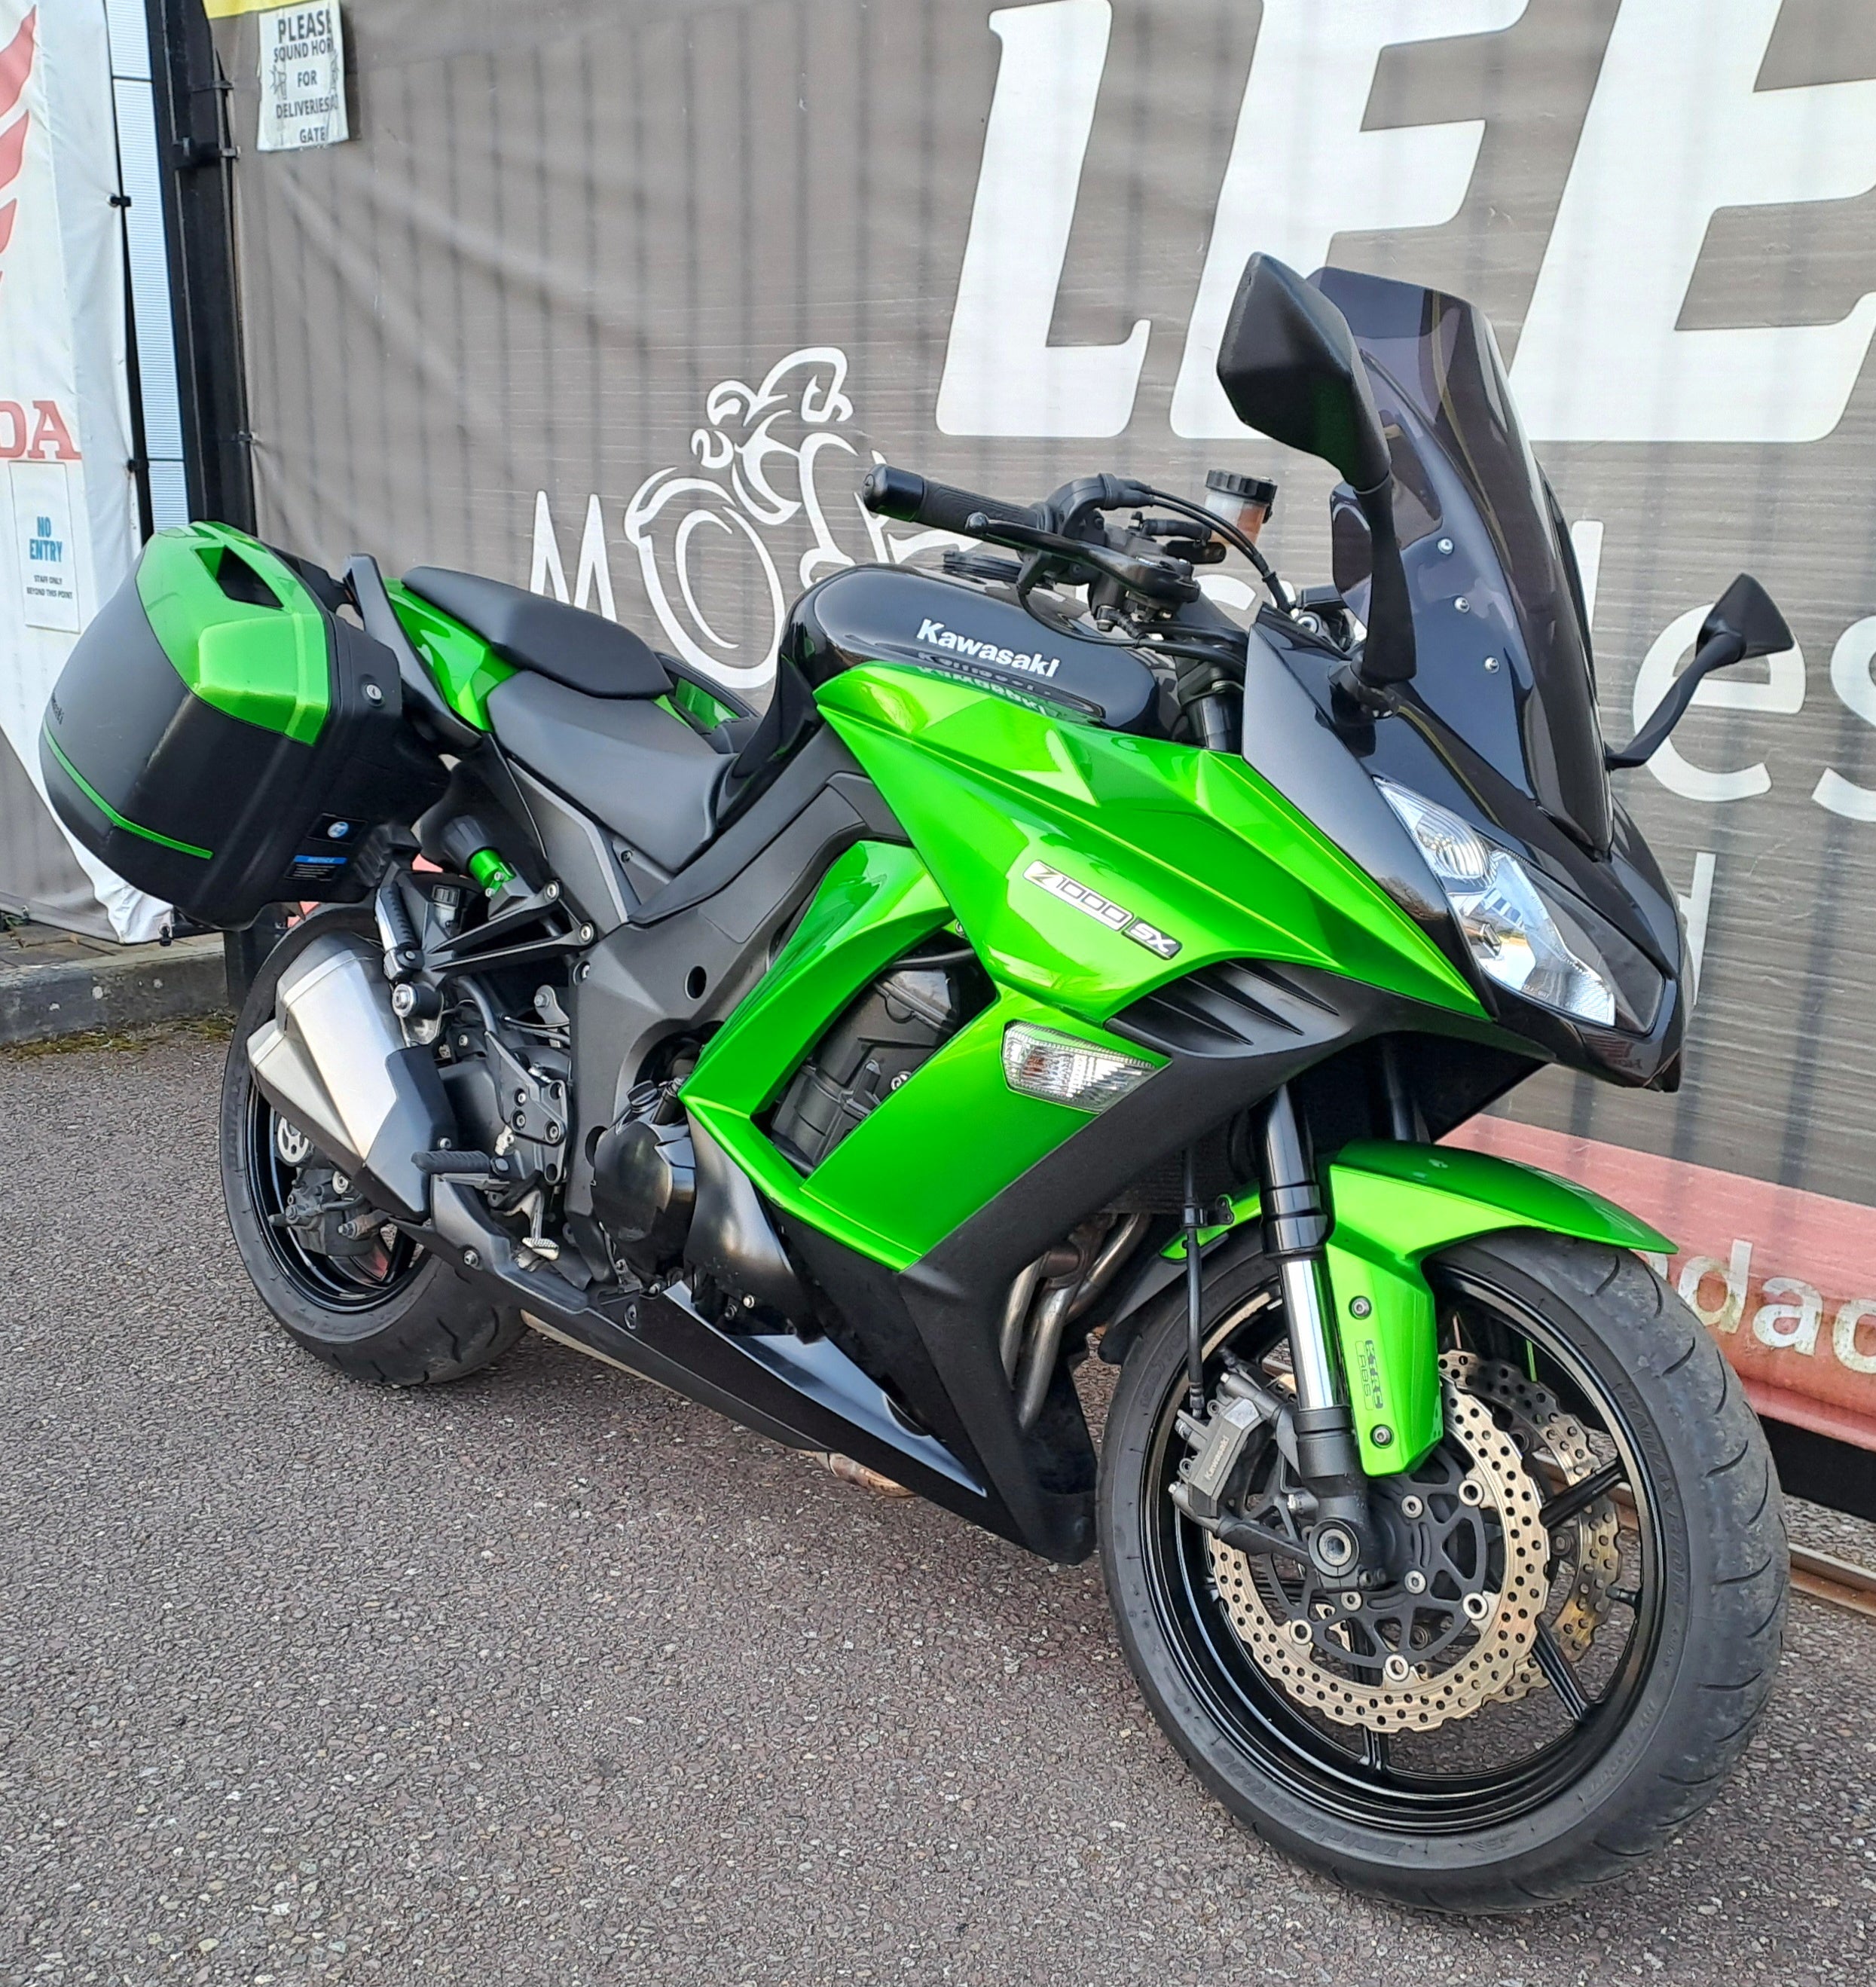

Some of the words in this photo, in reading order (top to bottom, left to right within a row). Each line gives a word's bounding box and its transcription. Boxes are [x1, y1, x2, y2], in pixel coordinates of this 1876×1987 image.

[273, 43, 309, 63] SOUND
[297, 70, 317, 87] FOR
[276, 96, 330, 119] DELIVERIES
[300, 127, 325, 143] GATE
[37, 516, 51, 538] NO
[29, 538, 63, 563] ENTRY
[916, 618, 1061, 677] Kawasaki
[1030, 864, 1129, 924] Z1000
[1130, 922, 1177, 953] SX
[1358, 1355, 1372, 1397] ABS
[1205, 1436, 1230, 1481] Kawasaki
